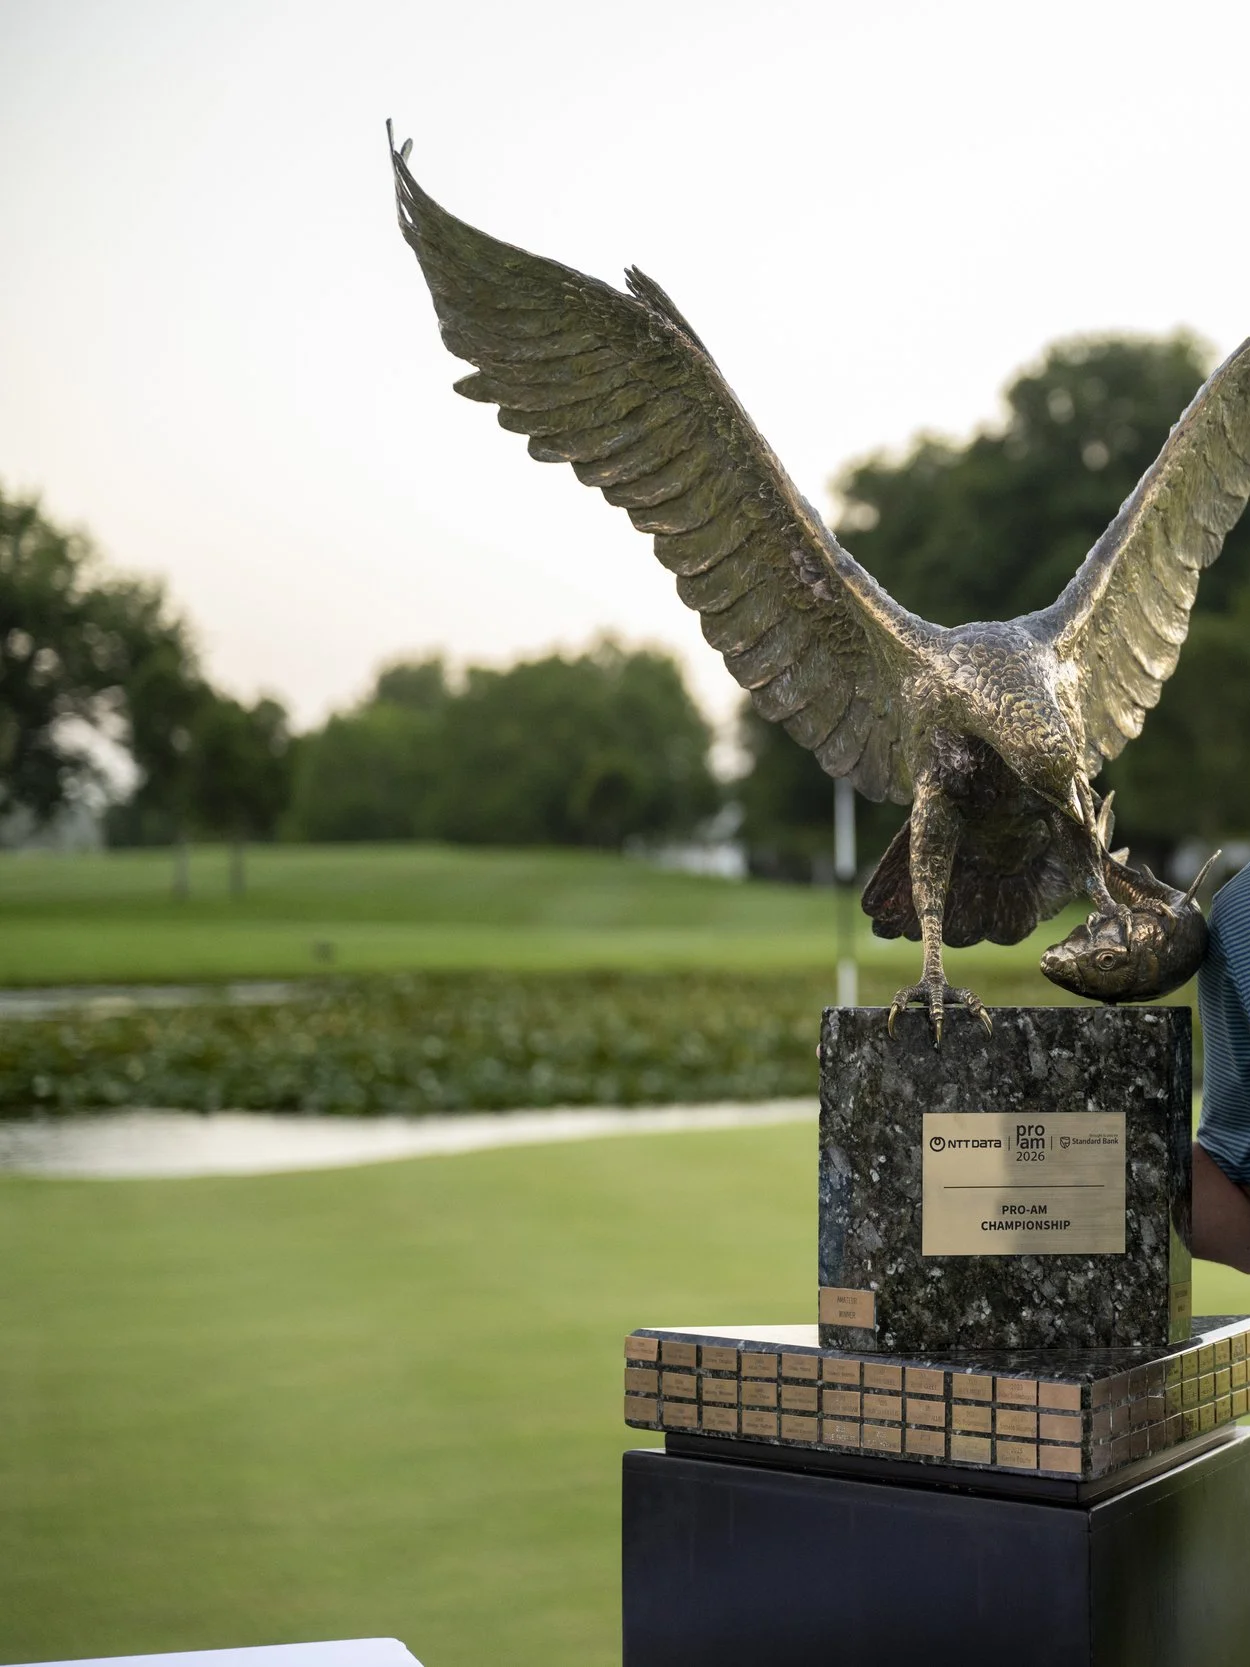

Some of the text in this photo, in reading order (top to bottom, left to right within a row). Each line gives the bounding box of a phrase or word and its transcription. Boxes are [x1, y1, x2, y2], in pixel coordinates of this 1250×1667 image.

[1016, 1124, 1045, 1144] pro
[947, 1139, 970, 1149] NTT
[1021, 1137, 1045, 1150] am
[1072, 1137, 1119, 1145] Standard Bank
[1016, 1151, 1045, 1162] 2026
[1002, 1205, 1047, 1215] PRO-AM
[981, 1220, 1071, 1231] CHAMPIONSHIP
